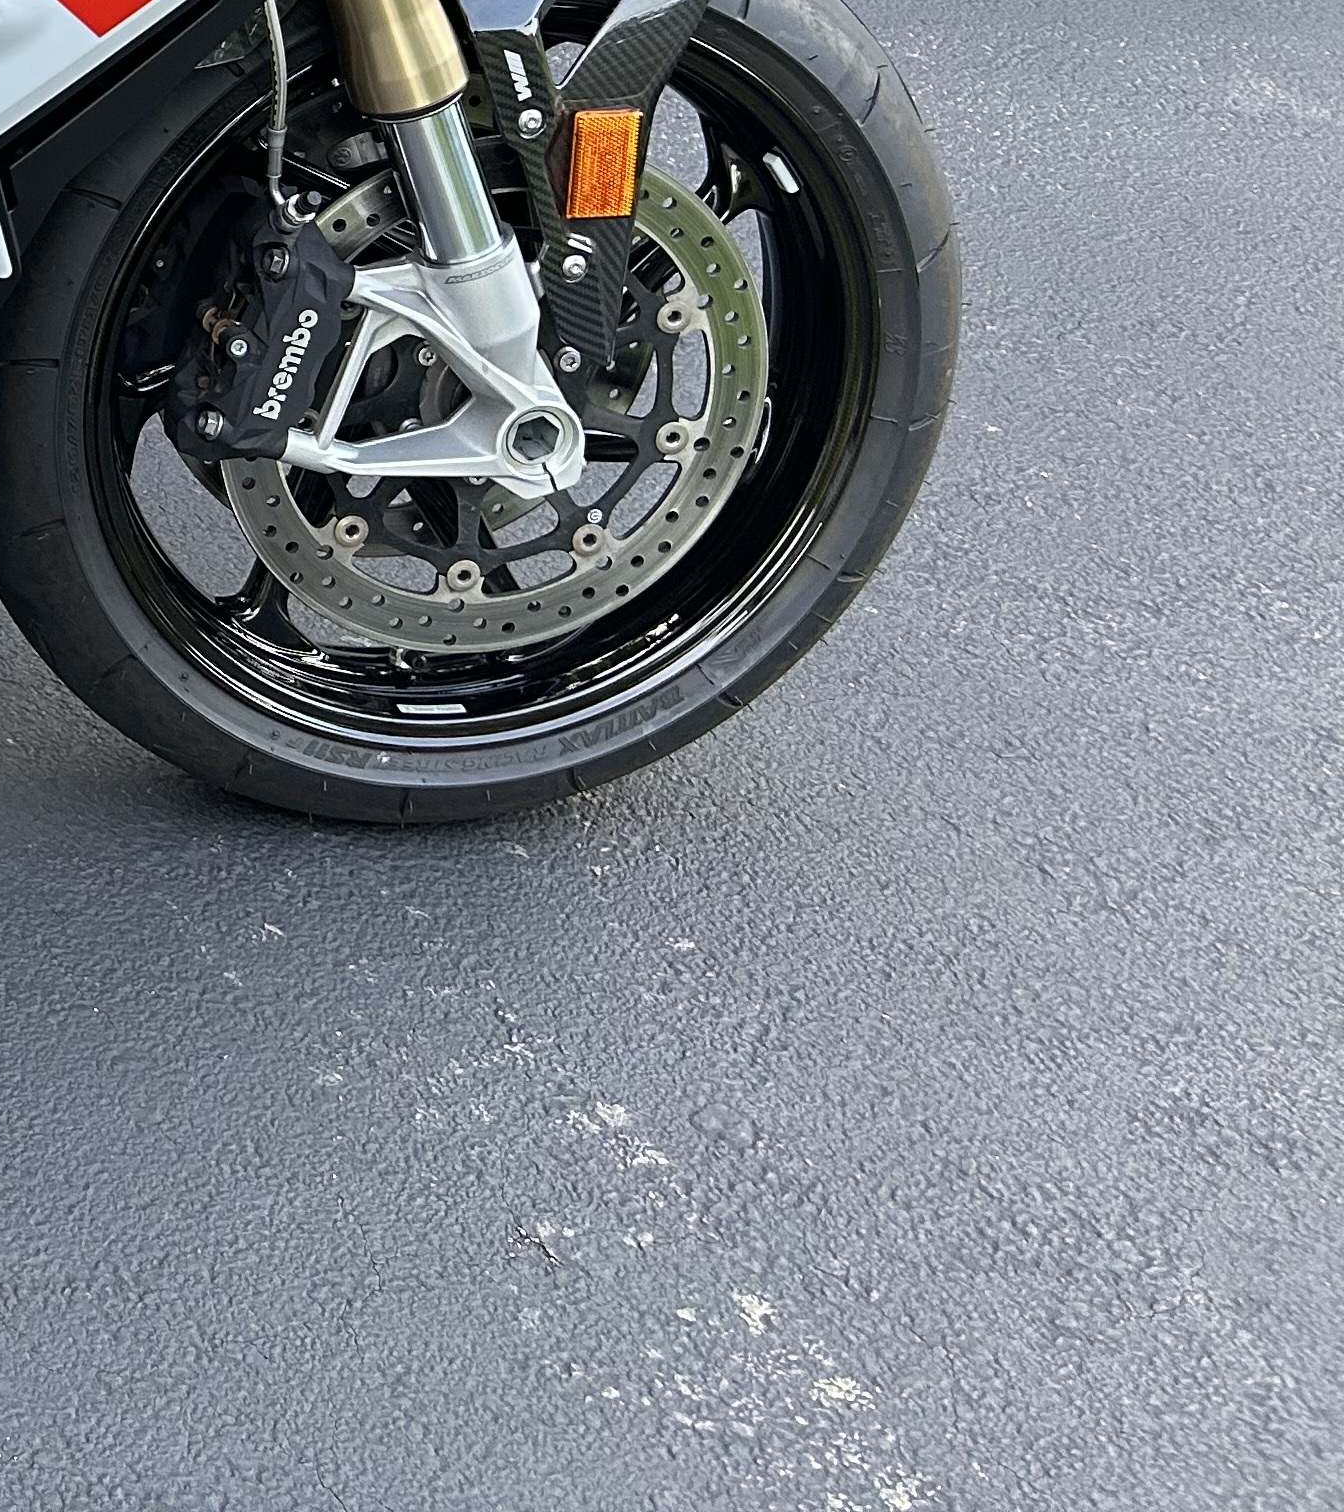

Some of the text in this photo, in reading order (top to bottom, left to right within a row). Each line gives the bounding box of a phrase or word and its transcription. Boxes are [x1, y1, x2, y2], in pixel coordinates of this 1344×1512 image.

[253, 309, 318, 420] brembo
[558, 685, 688, 756] BATTLAX
[460, 744, 550, 770] RACING
